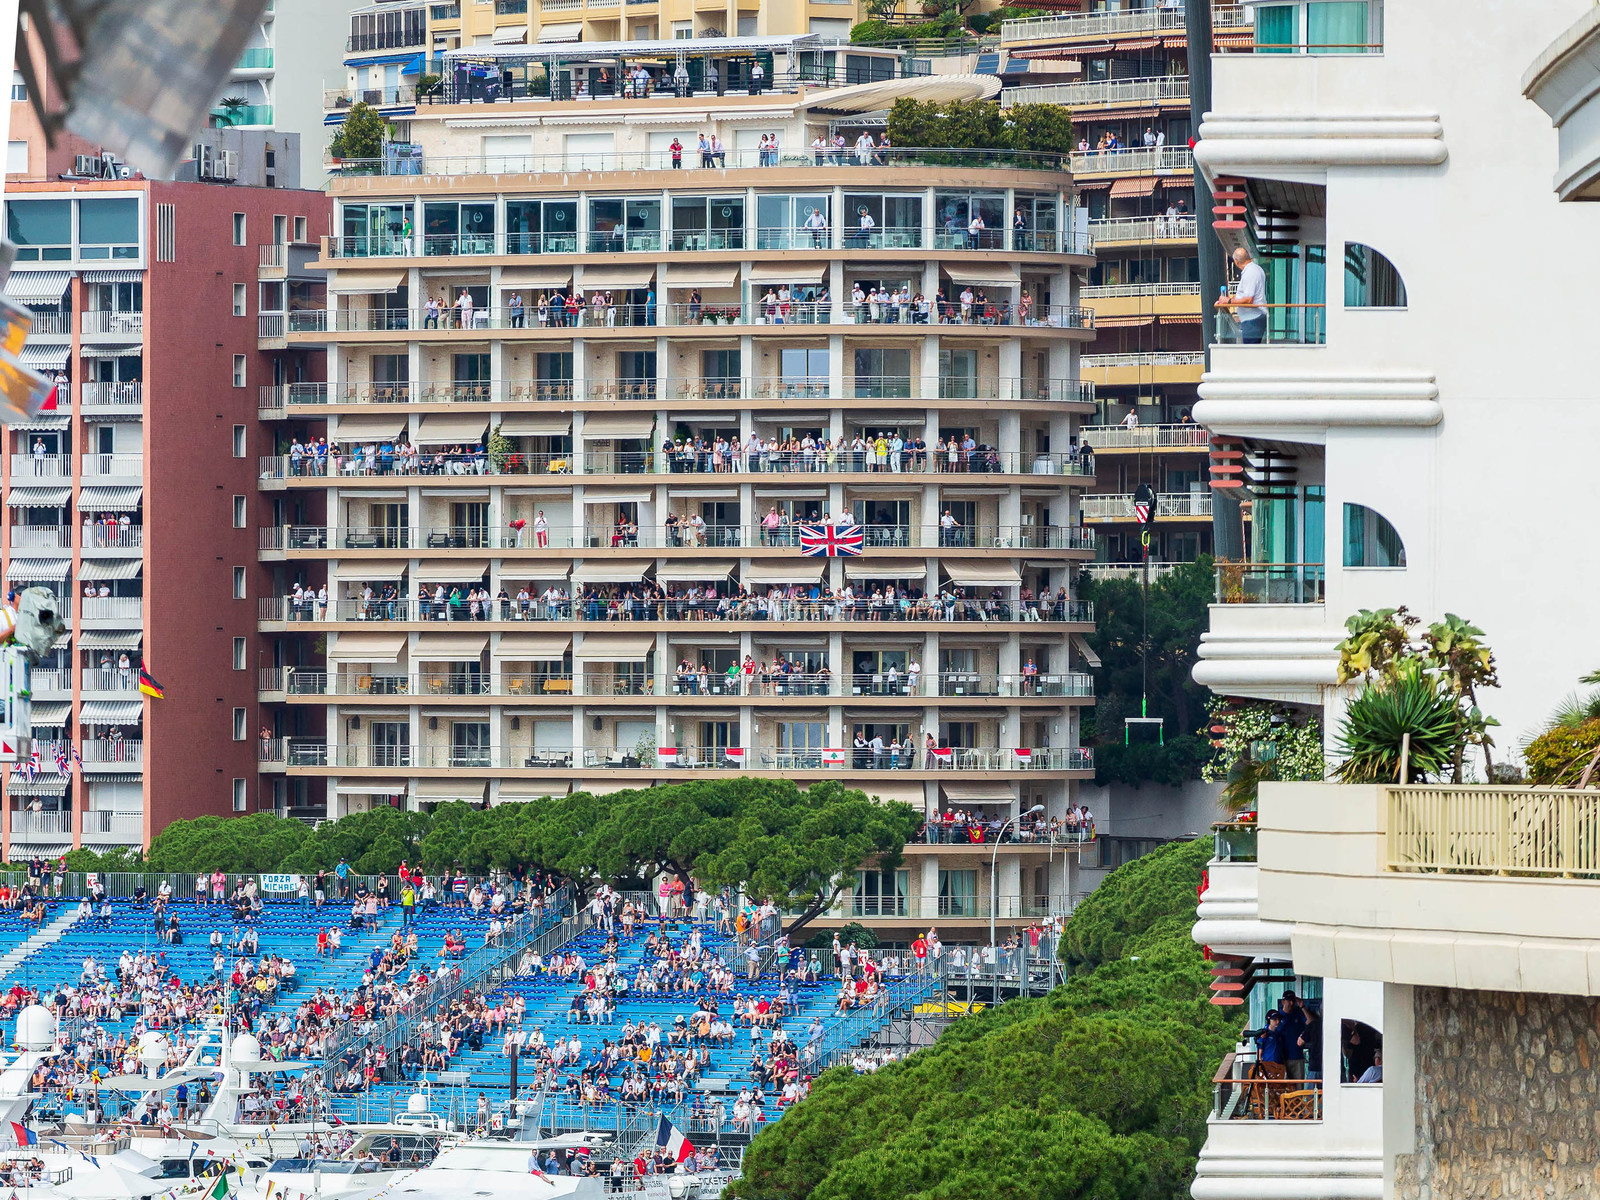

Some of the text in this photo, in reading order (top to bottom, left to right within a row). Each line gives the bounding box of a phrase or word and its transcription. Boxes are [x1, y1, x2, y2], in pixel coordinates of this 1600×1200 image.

[263, 874, 291, 883] FORZA
[264, 882, 299, 891] MICHAEL
[492, 1119, 502, 1129] K1
